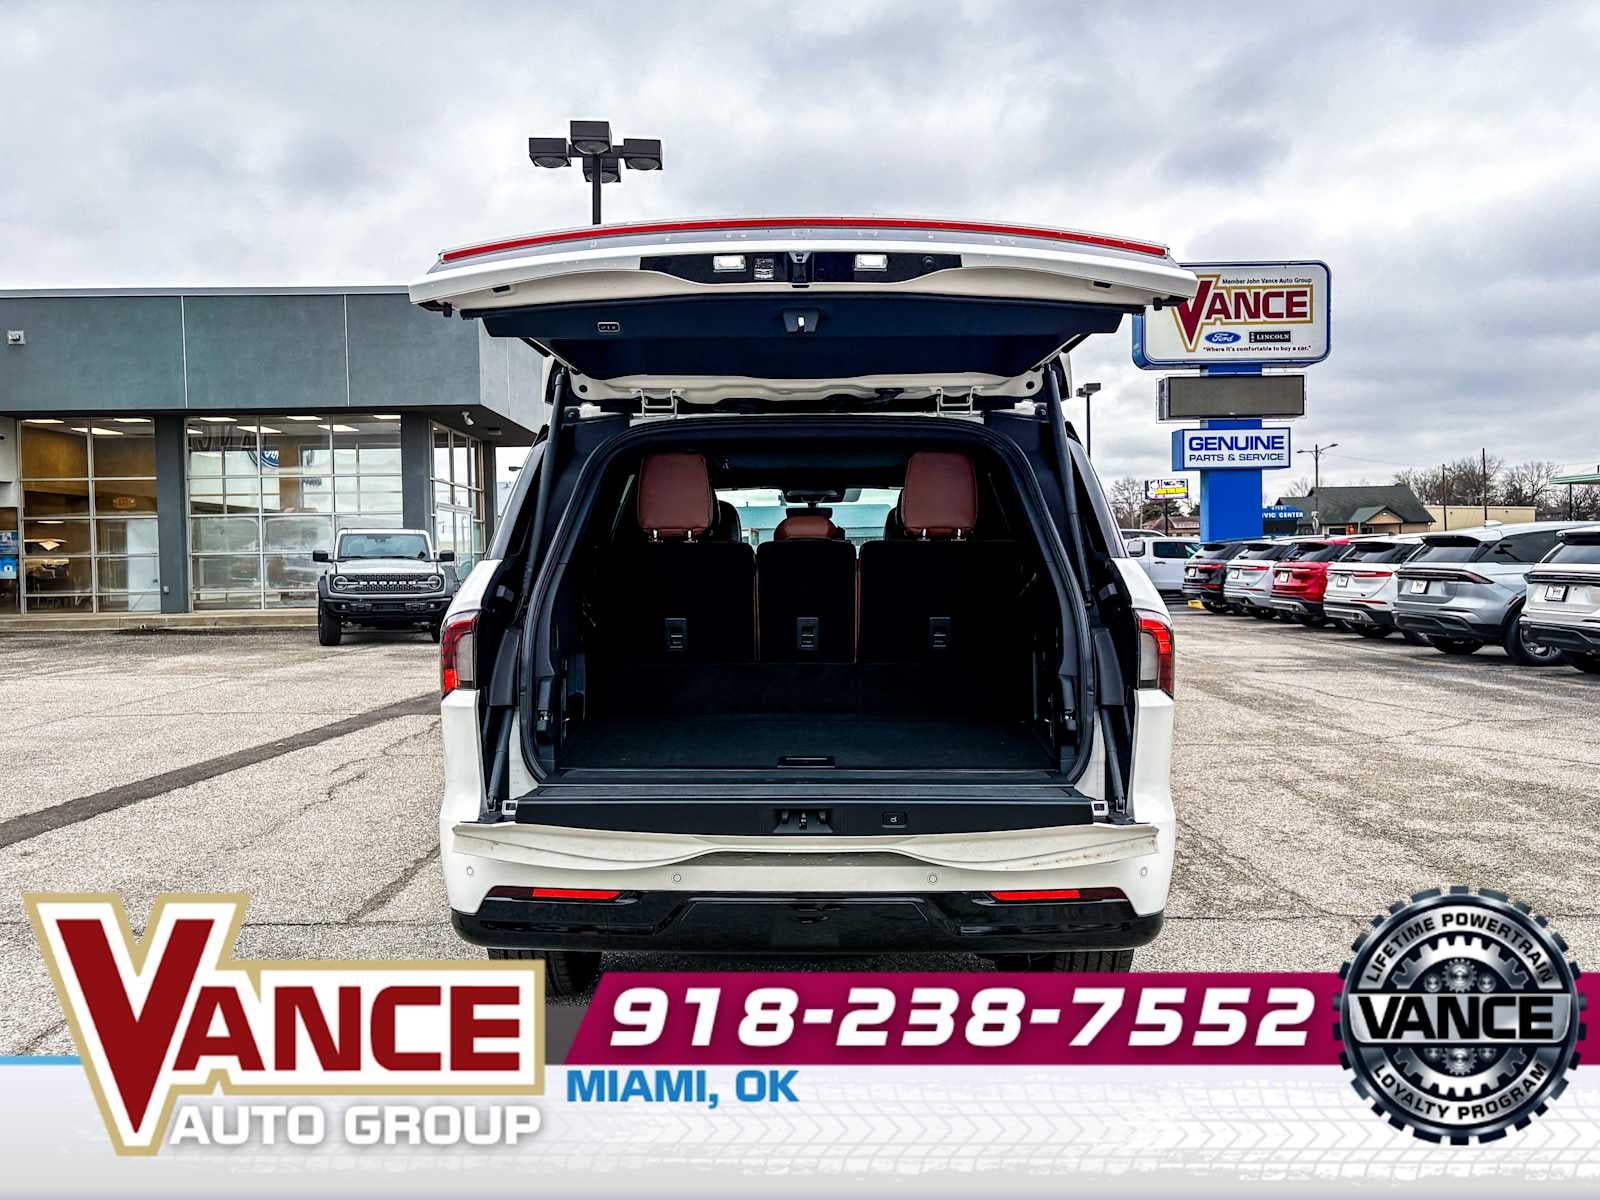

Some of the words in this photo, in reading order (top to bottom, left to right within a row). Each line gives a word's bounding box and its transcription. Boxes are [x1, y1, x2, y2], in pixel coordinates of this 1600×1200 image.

[1176, 280, 1308, 344] VANCE
[1256, 333, 1290, 341] LINCOLN
[1189, 435, 1284, 451] GENUINE
[1189, 454, 1225, 462] PARTS
[1228, 453, 1235, 461] &
[1238, 453, 1285, 461] SERVICE
[1278, 511, 1304, 519] CENTER
